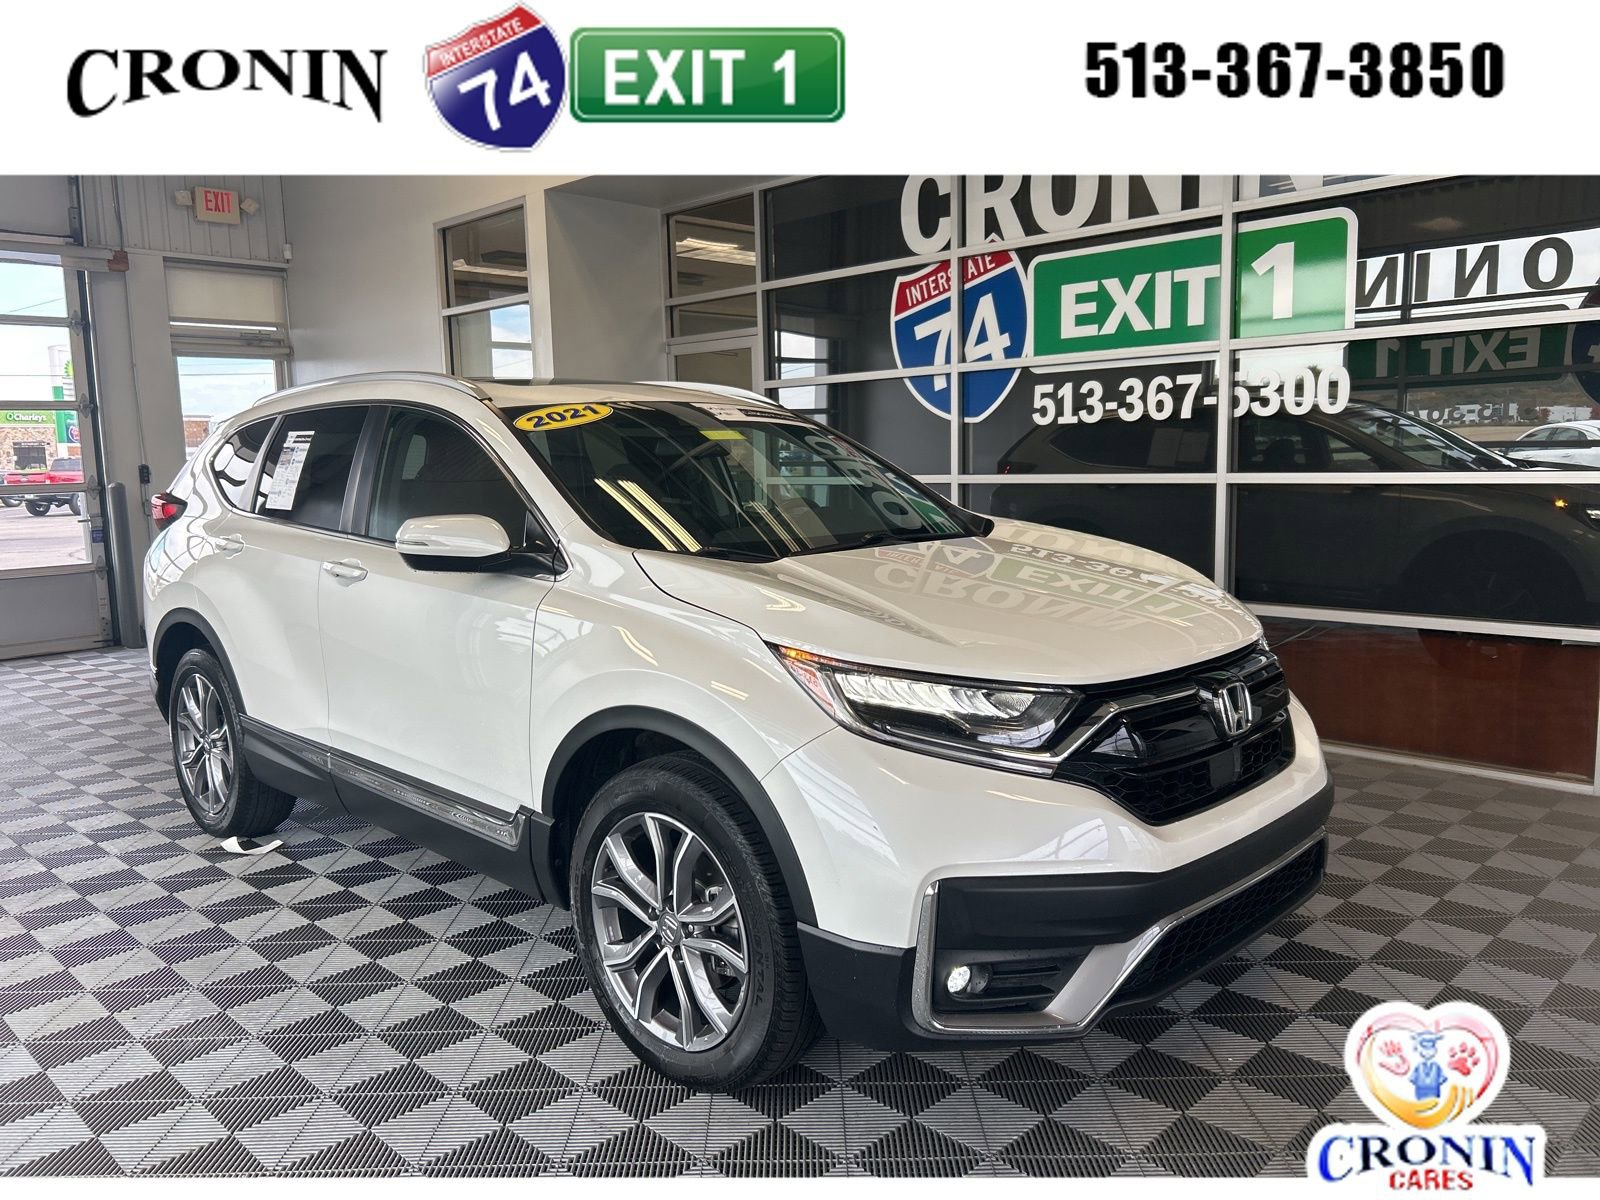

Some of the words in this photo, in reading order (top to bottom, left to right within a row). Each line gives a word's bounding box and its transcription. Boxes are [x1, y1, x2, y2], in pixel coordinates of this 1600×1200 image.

[203, 190, 232, 213] EXIT
[906, 254, 996, 307] INTERATE
[1061, 264, 1221, 340] EXIT
[1251, 241, 1295, 320] 1
[914, 293, 1011, 392] 74
[526, 405, 601, 428] 2021
